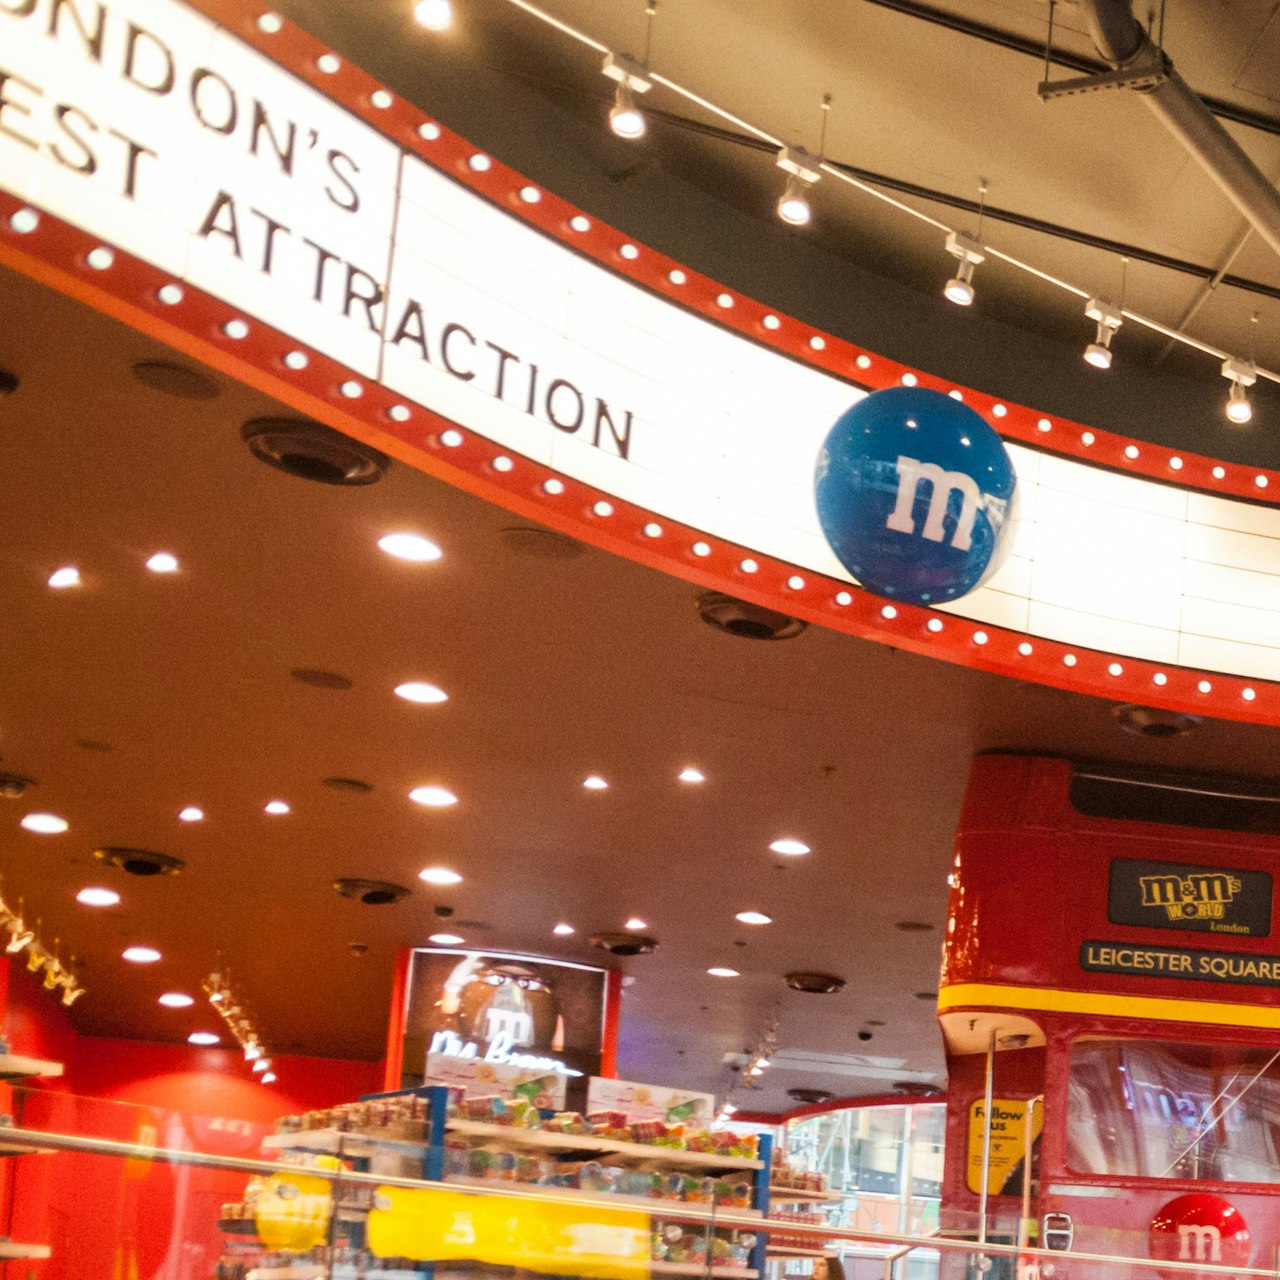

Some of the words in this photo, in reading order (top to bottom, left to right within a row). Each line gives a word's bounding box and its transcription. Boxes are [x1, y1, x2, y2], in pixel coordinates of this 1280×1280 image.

[198, 189, 635, 461] ATTRACTION
[886, 455, 983, 552] m
[1210, 922, 1251, 934] London
[1088, 947, 1194, 972] LEICESTER
[1178, 1224, 1223, 1262] m
